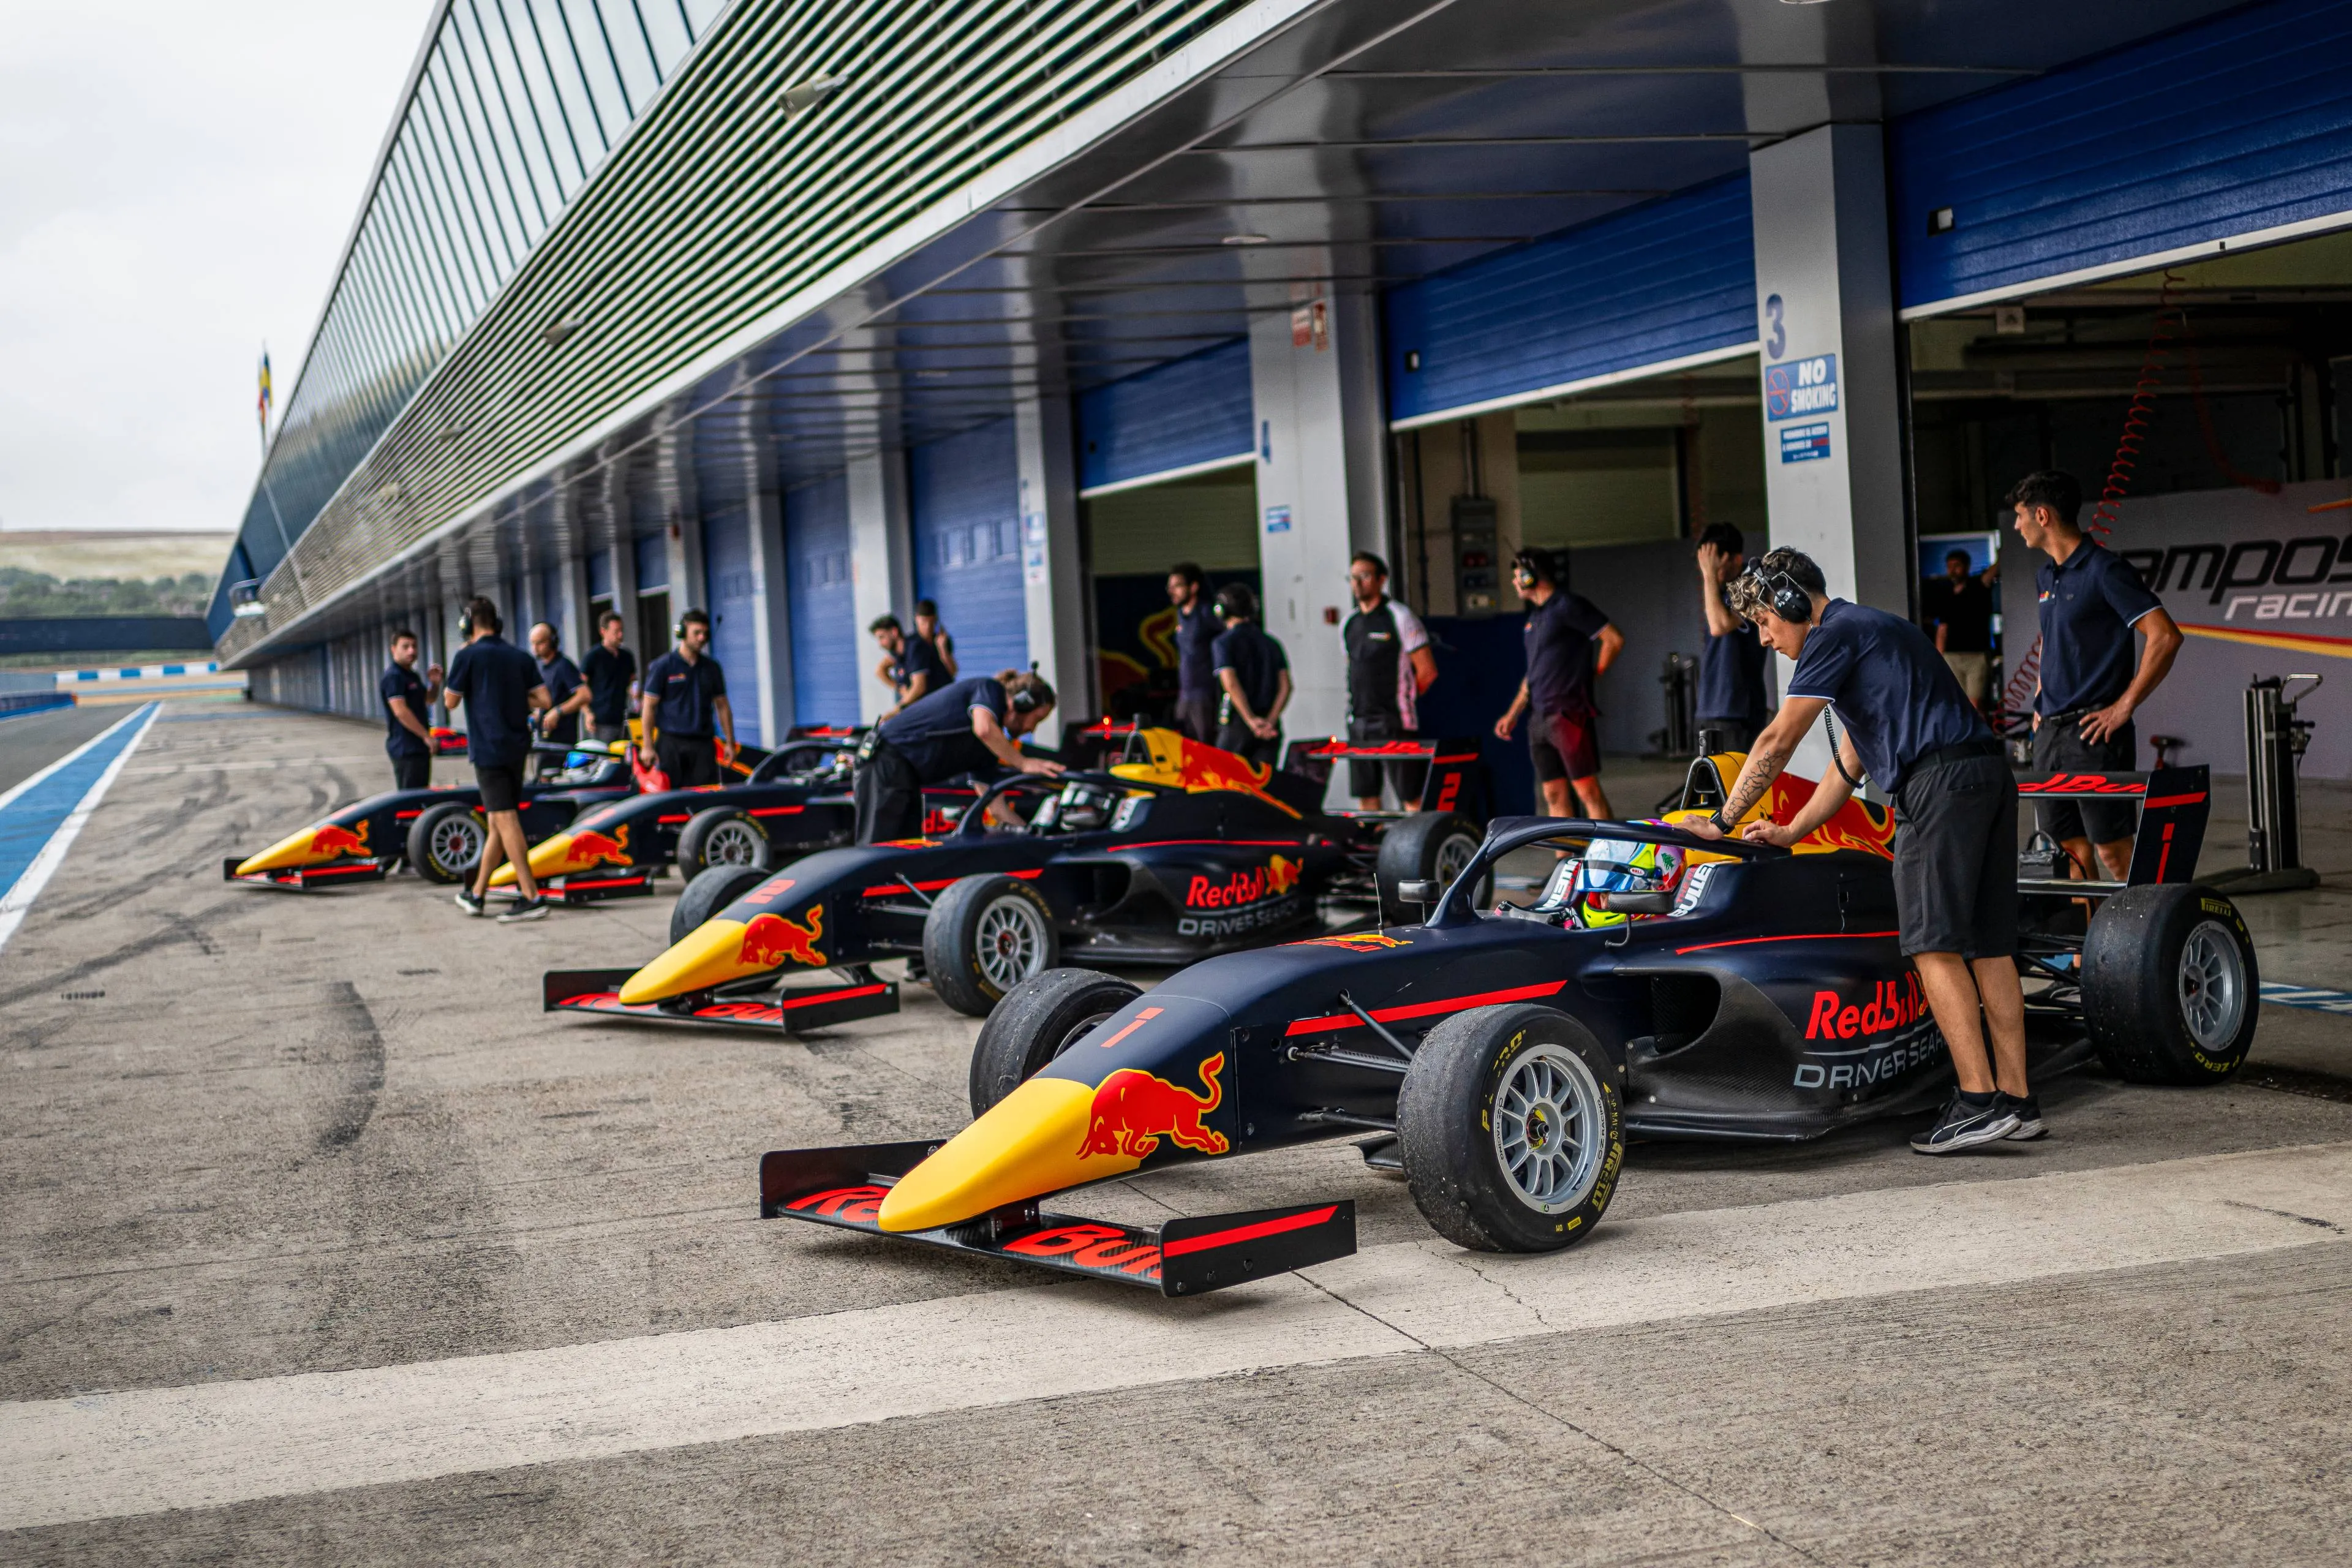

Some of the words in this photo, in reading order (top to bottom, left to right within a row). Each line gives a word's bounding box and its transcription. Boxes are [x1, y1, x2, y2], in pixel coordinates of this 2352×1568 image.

[1765, 293, 1786, 360] 3
[1798, 358, 1826, 386] NO
[1791, 382, 1836, 413] SMOKING
[1794, 1052, 1908, 1089] DRIVER
